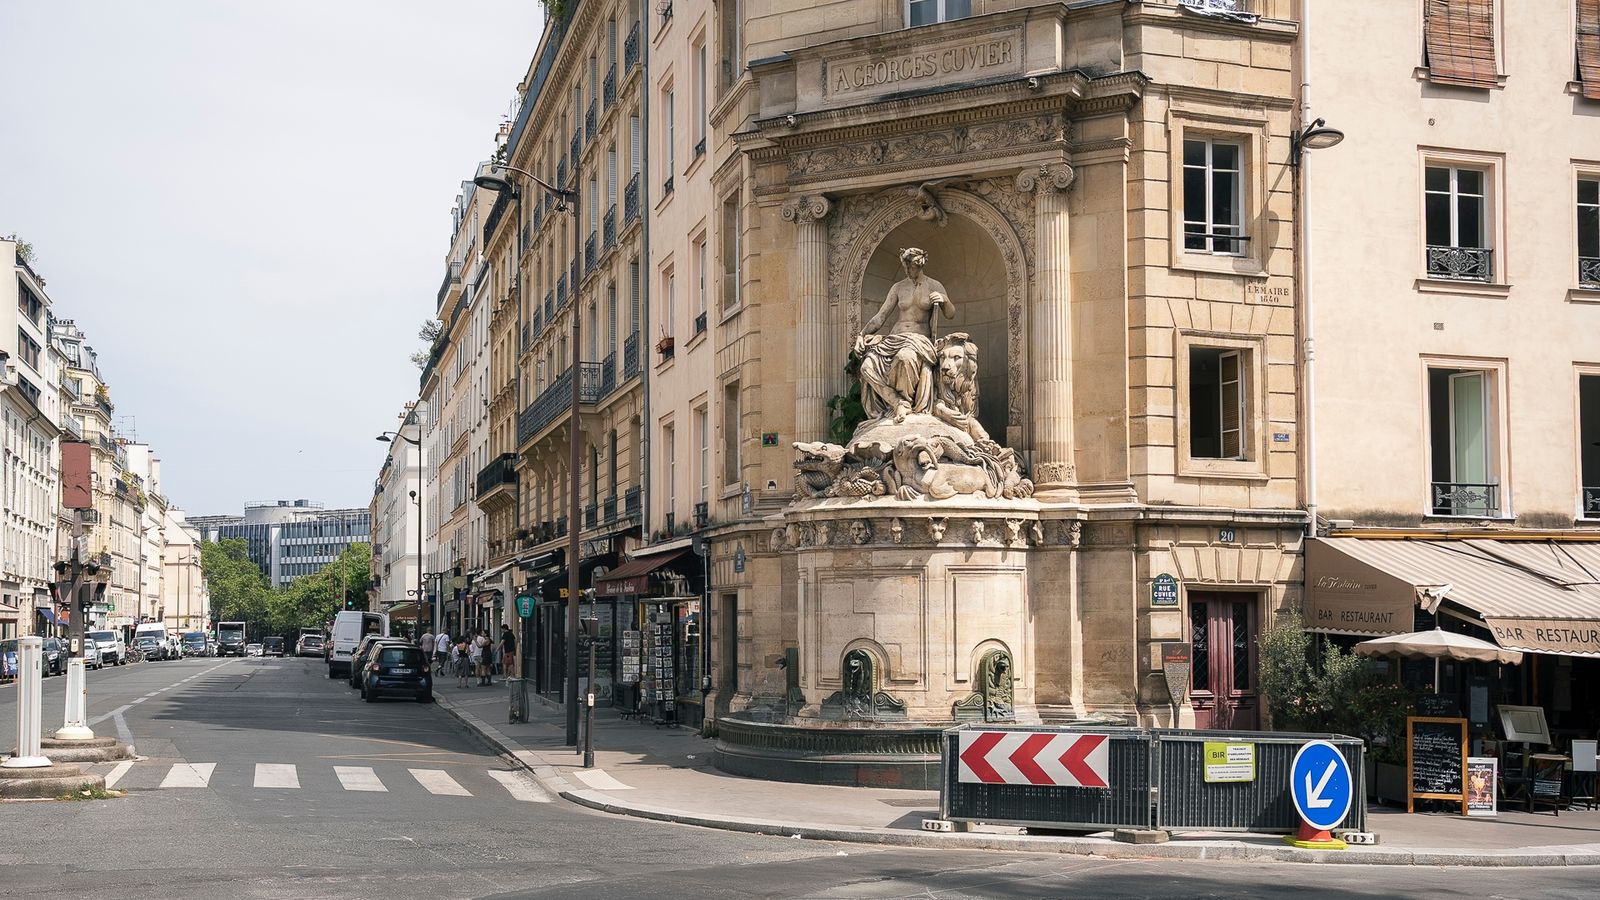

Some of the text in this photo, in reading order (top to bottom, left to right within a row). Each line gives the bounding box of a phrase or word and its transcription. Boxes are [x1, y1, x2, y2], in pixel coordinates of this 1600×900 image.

[835, 41, 1012, 92] A GEORGES CUVIER
[1248, 286, 1289, 296] LEMAIRE
[1220, 531, 1233, 541] 20
[1318, 609, 1394, 623] BAR RESTAURANT
[1495, 627, 1600, 643] BAR RESTAUR
